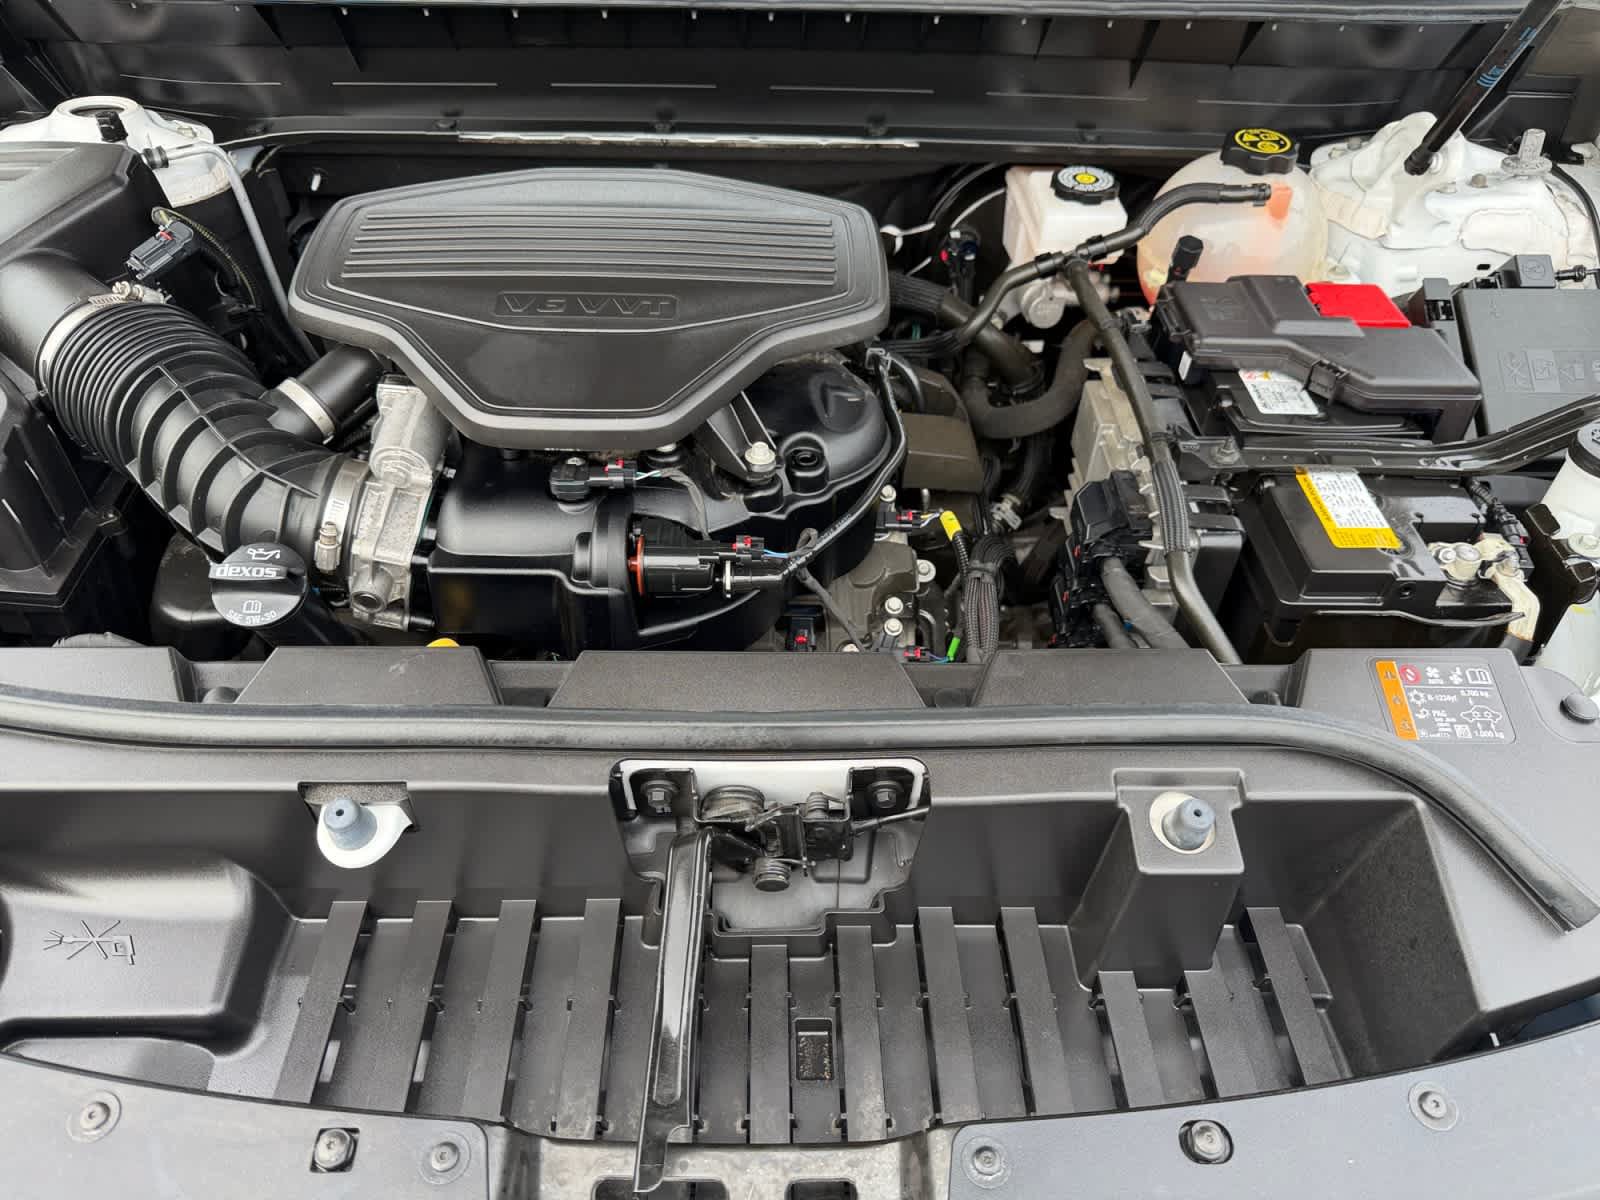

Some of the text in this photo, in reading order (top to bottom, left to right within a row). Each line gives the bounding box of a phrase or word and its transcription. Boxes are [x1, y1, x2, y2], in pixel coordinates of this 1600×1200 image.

[503, 295, 670, 315] V6 VVT
[215, 564, 279, 578] dexos
